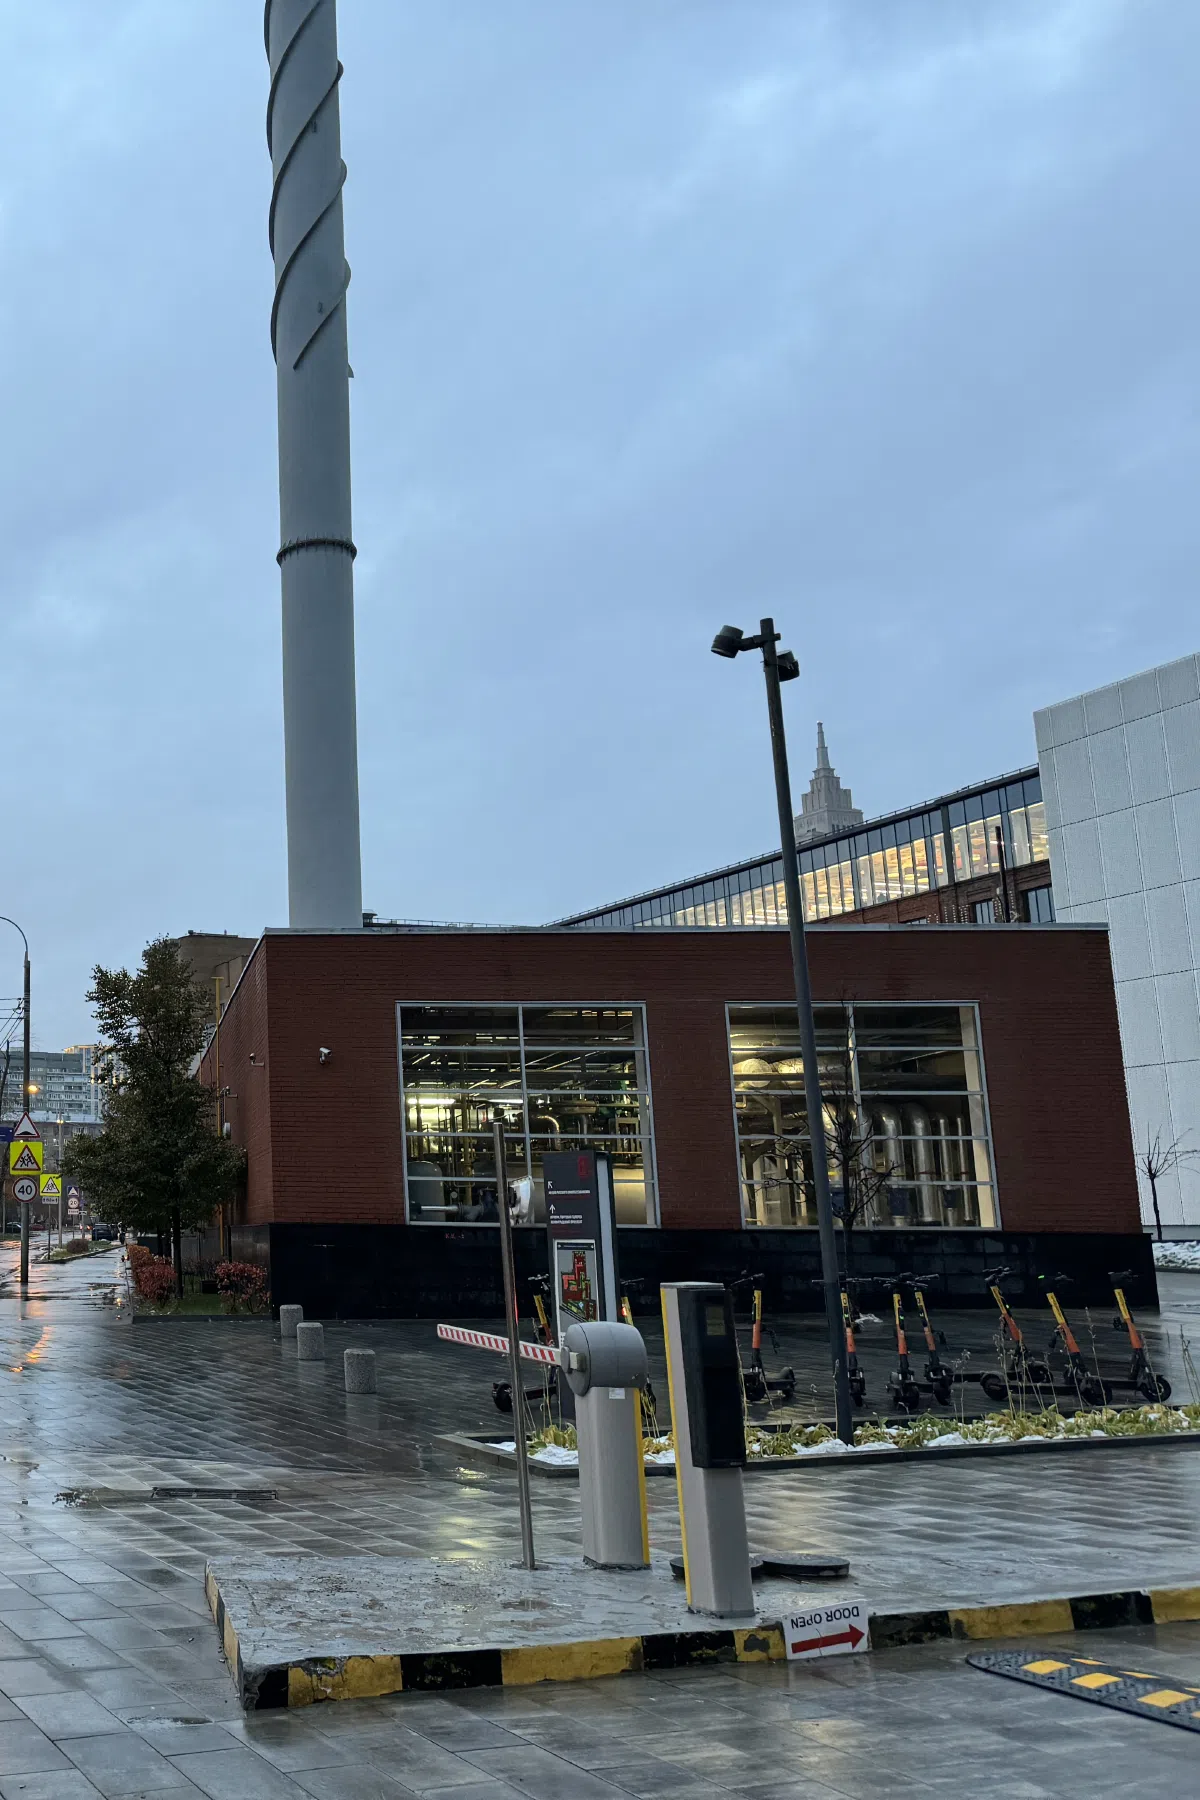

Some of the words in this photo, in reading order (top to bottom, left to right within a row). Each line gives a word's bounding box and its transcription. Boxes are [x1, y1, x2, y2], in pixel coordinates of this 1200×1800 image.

[18, 1185, 33, 1195] 40
[790, 1613, 822, 1629] OPEN
[825, 1606, 860, 1622] DOOR
